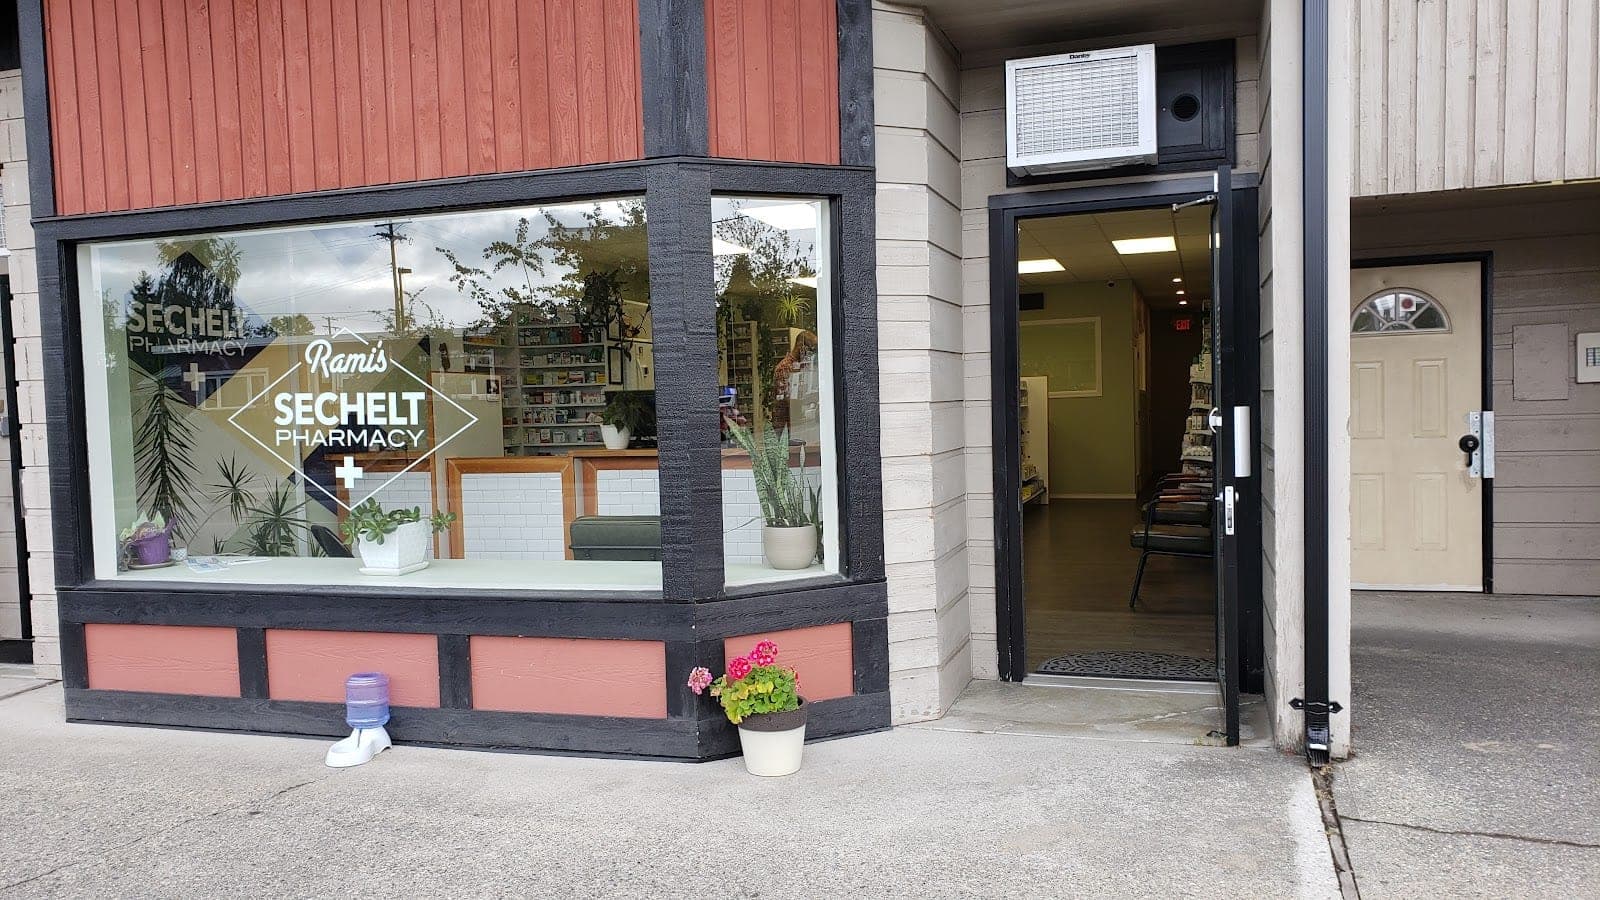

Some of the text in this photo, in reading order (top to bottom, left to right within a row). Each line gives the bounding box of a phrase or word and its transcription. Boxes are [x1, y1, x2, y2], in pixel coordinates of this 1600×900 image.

[126, 300, 246, 339] SECHELT
[1176, 319, 1190, 330] EXIT
[129, 334, 249, 357] PHARMACY
[304, 339, 388, 379] Rami's
[273, 391, 426, 426] SECHELT
[275, 428, 425, 448] PHARMACY
